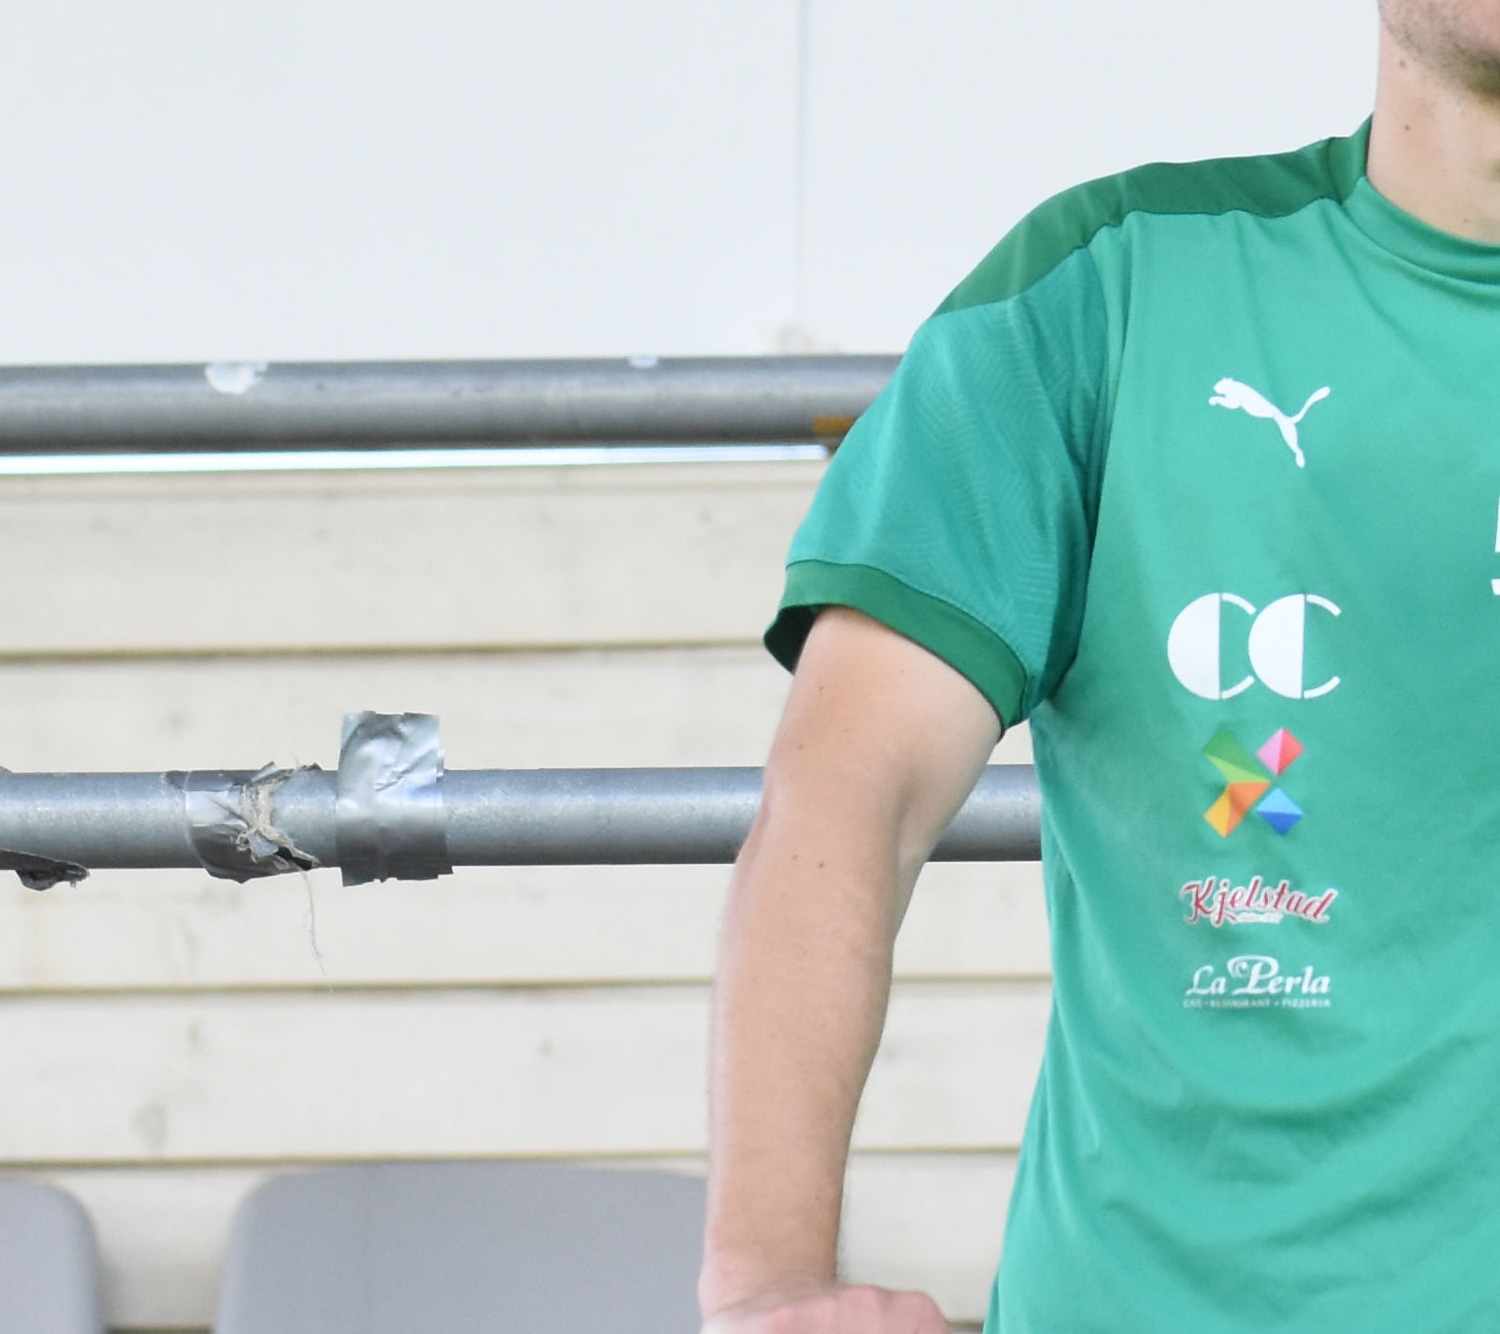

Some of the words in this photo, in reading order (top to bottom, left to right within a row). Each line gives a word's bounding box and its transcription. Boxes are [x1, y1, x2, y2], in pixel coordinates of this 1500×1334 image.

[1180, 876, 1337, 927] Kjelstad
[1185, 965, 1226, 996] La
[1227, 955, 1331, 996] Perla
